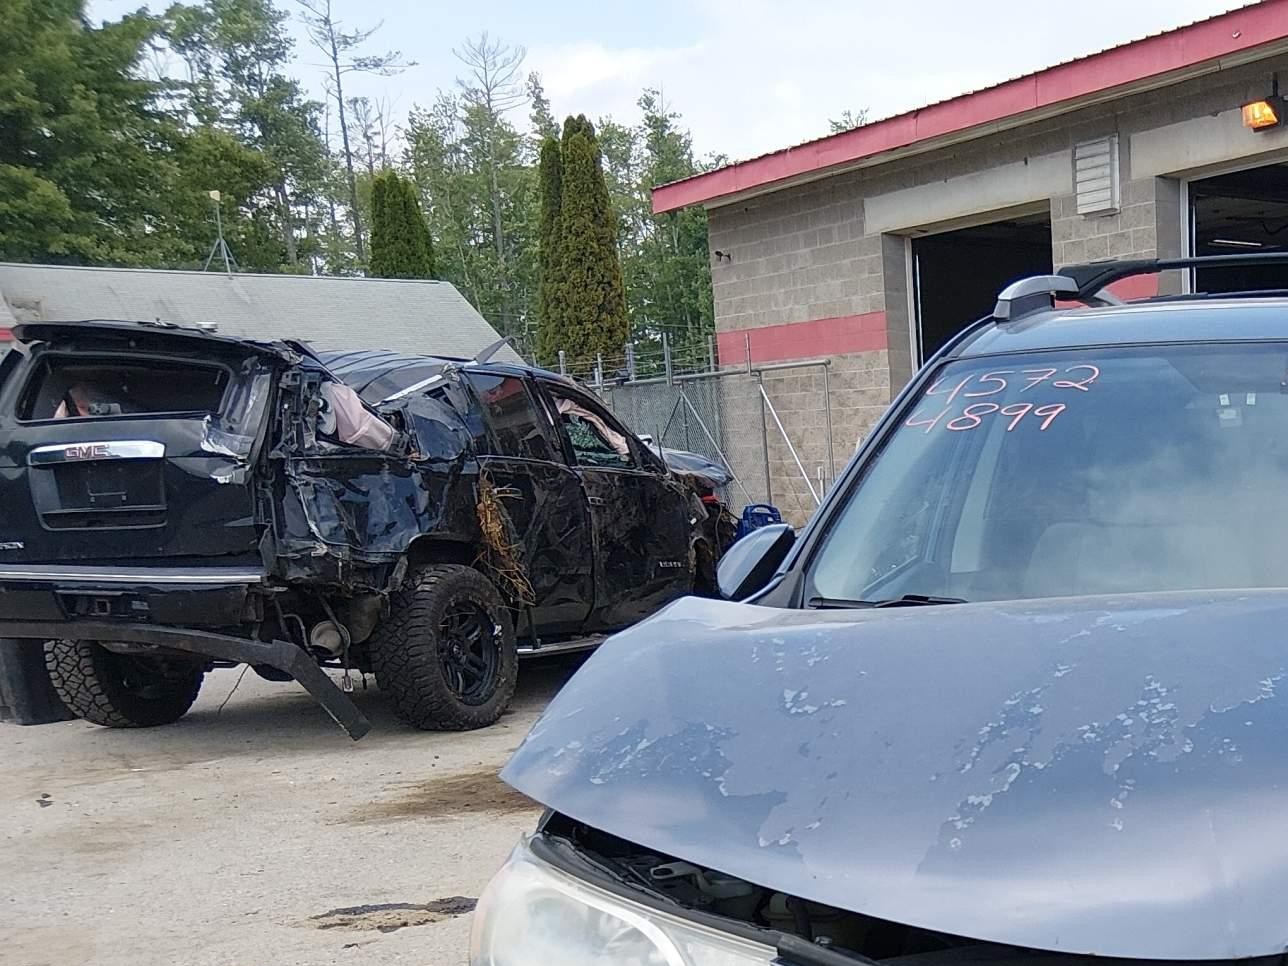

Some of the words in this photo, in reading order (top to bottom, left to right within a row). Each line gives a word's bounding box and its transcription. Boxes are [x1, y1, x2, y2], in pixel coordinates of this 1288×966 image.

[926, 365, 1099, 404] 4572
[905, 402, 1066, 434] 4899
[64, 444, 110, 460] GMC
